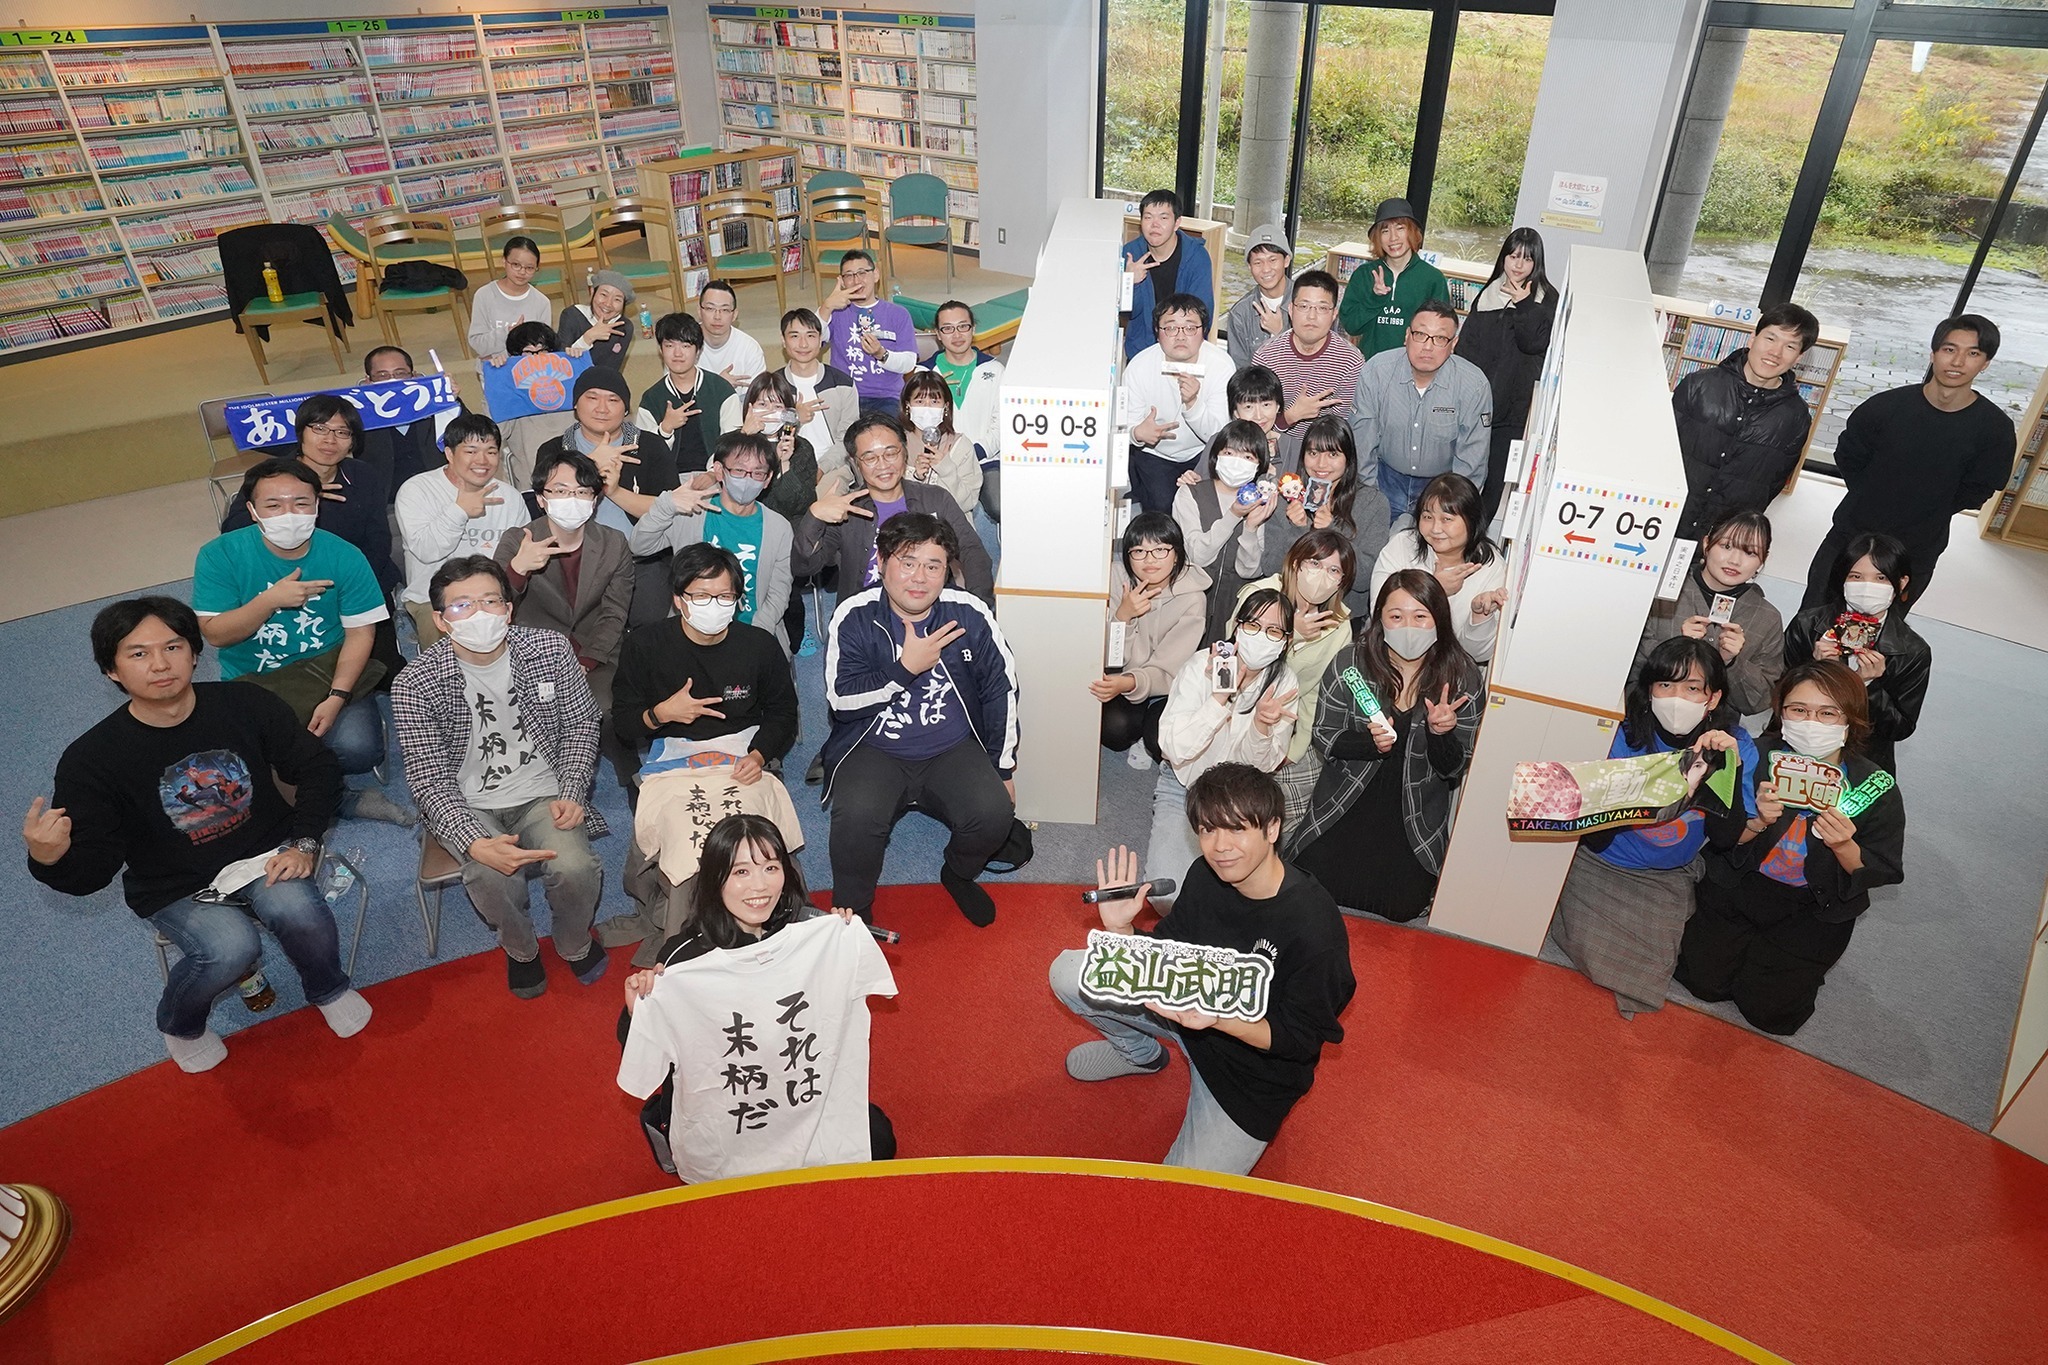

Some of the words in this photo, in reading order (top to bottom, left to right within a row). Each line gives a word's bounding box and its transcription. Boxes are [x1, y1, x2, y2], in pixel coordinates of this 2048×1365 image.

[567, 9, 600, 21] 1-26
[760, 8, 785, 18] 1-27
[904, 15, 934, 26] 1-28
[12, 31, 76, 45] 1-24
[336, 20, 380, 33] 1-25
[1714, 304, 1753, 321] 0-13
[1012, 413, 1048, 435] 0-9
[1061, 415, 1097, 438] 0-8
[1558, 501, 1605, 529] 0-7
[1615, 511, 1662, 541] 0-6
[475, 692, 513, 793] 末柄だ
[1520, 819, 1574, 832] TAKEAKI
[1576, 807, 1643, 831] MASUYAMA
[1086, 946, 1261, 1012] 益山武明
[775, 990, 823, 1107] それは
[720, 1011, 779, 1135] 末柄だ
